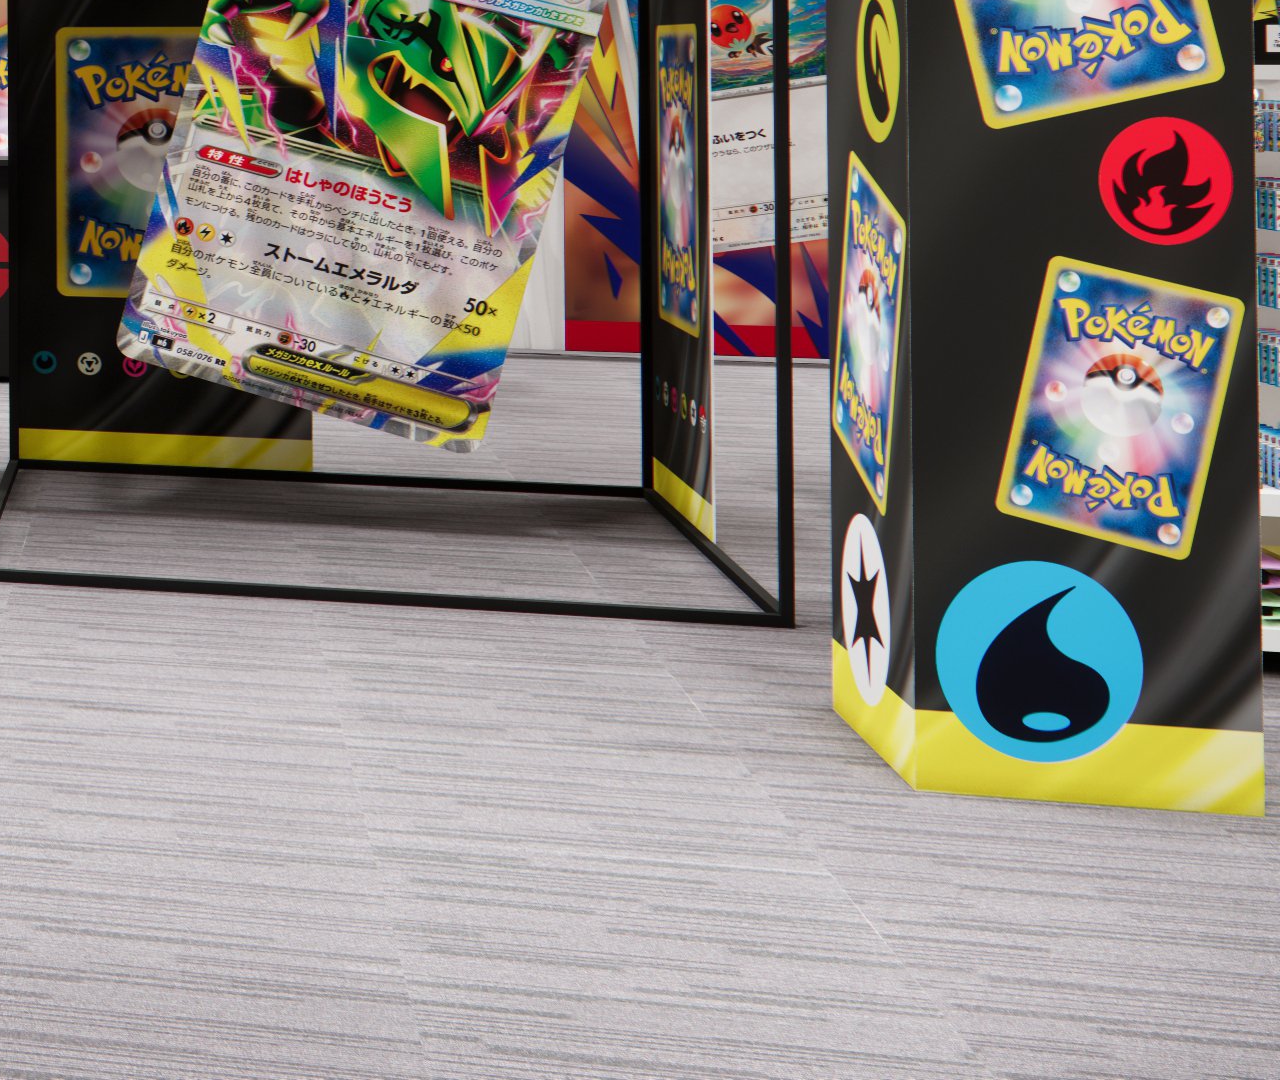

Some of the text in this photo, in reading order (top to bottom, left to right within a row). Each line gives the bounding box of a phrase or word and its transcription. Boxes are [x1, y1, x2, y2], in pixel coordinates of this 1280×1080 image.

[206, 148, 245, 167] 特性
[285, 167, 412, 213] はしゃのほうこう
[166, 258, 211, 279] ダメージ。
[264, 242, 420, 295] ストームエメラルダ
[177, 347, 213, 363] 058/076
[215, 358, 226, 367] RR
[293, 339, 316, 352] -30
[265, 348, 350, 377] メガシンカexルール
